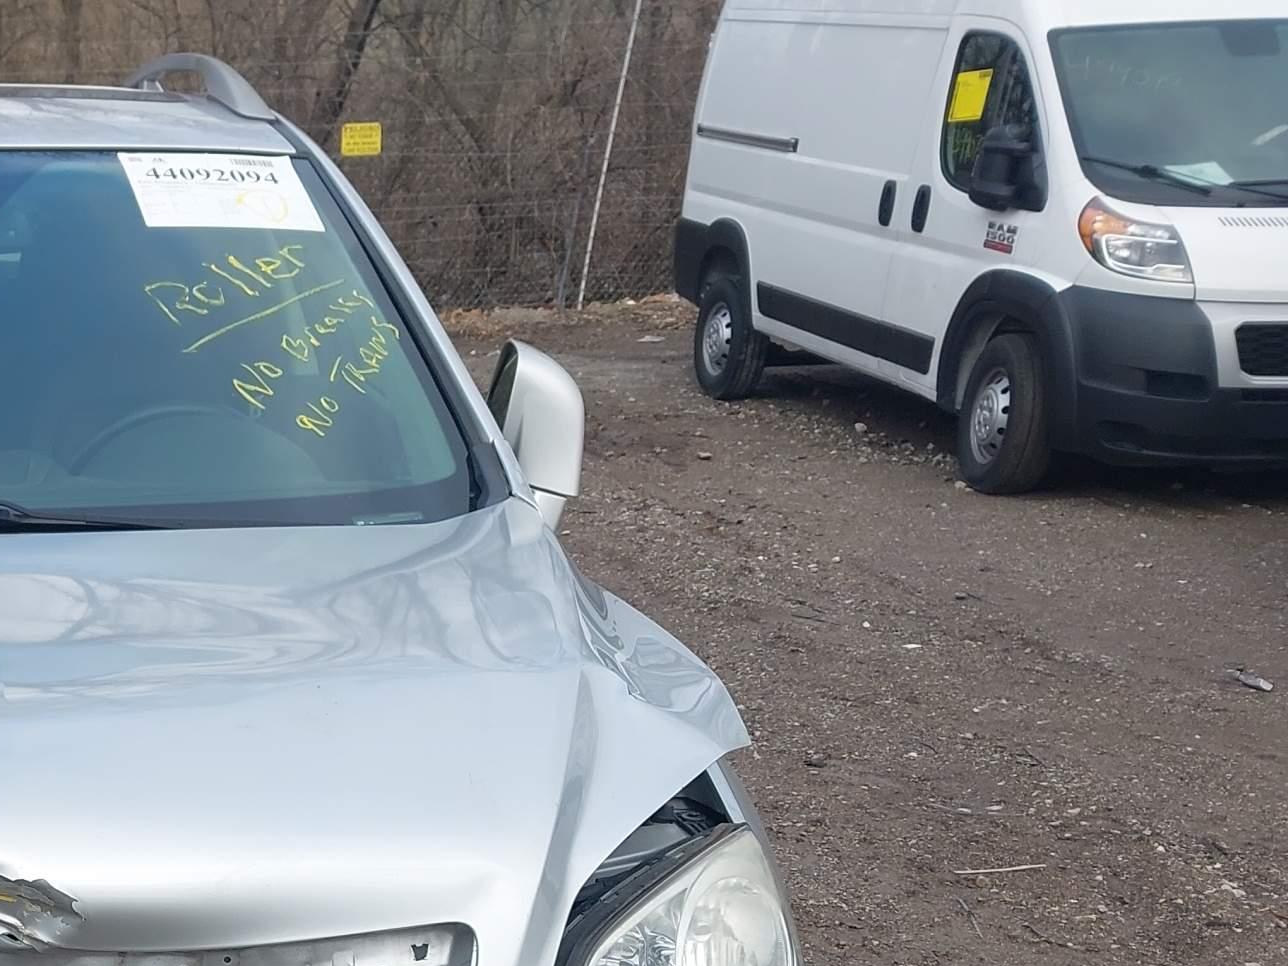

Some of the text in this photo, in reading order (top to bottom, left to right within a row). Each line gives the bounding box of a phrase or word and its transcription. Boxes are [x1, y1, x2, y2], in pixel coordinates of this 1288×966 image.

[145, 166, 279, 185] 44092094
[144, 244, 306, 327] Roller
[232, 361, 284, 410] No
[295, 395, 339, 437] No
